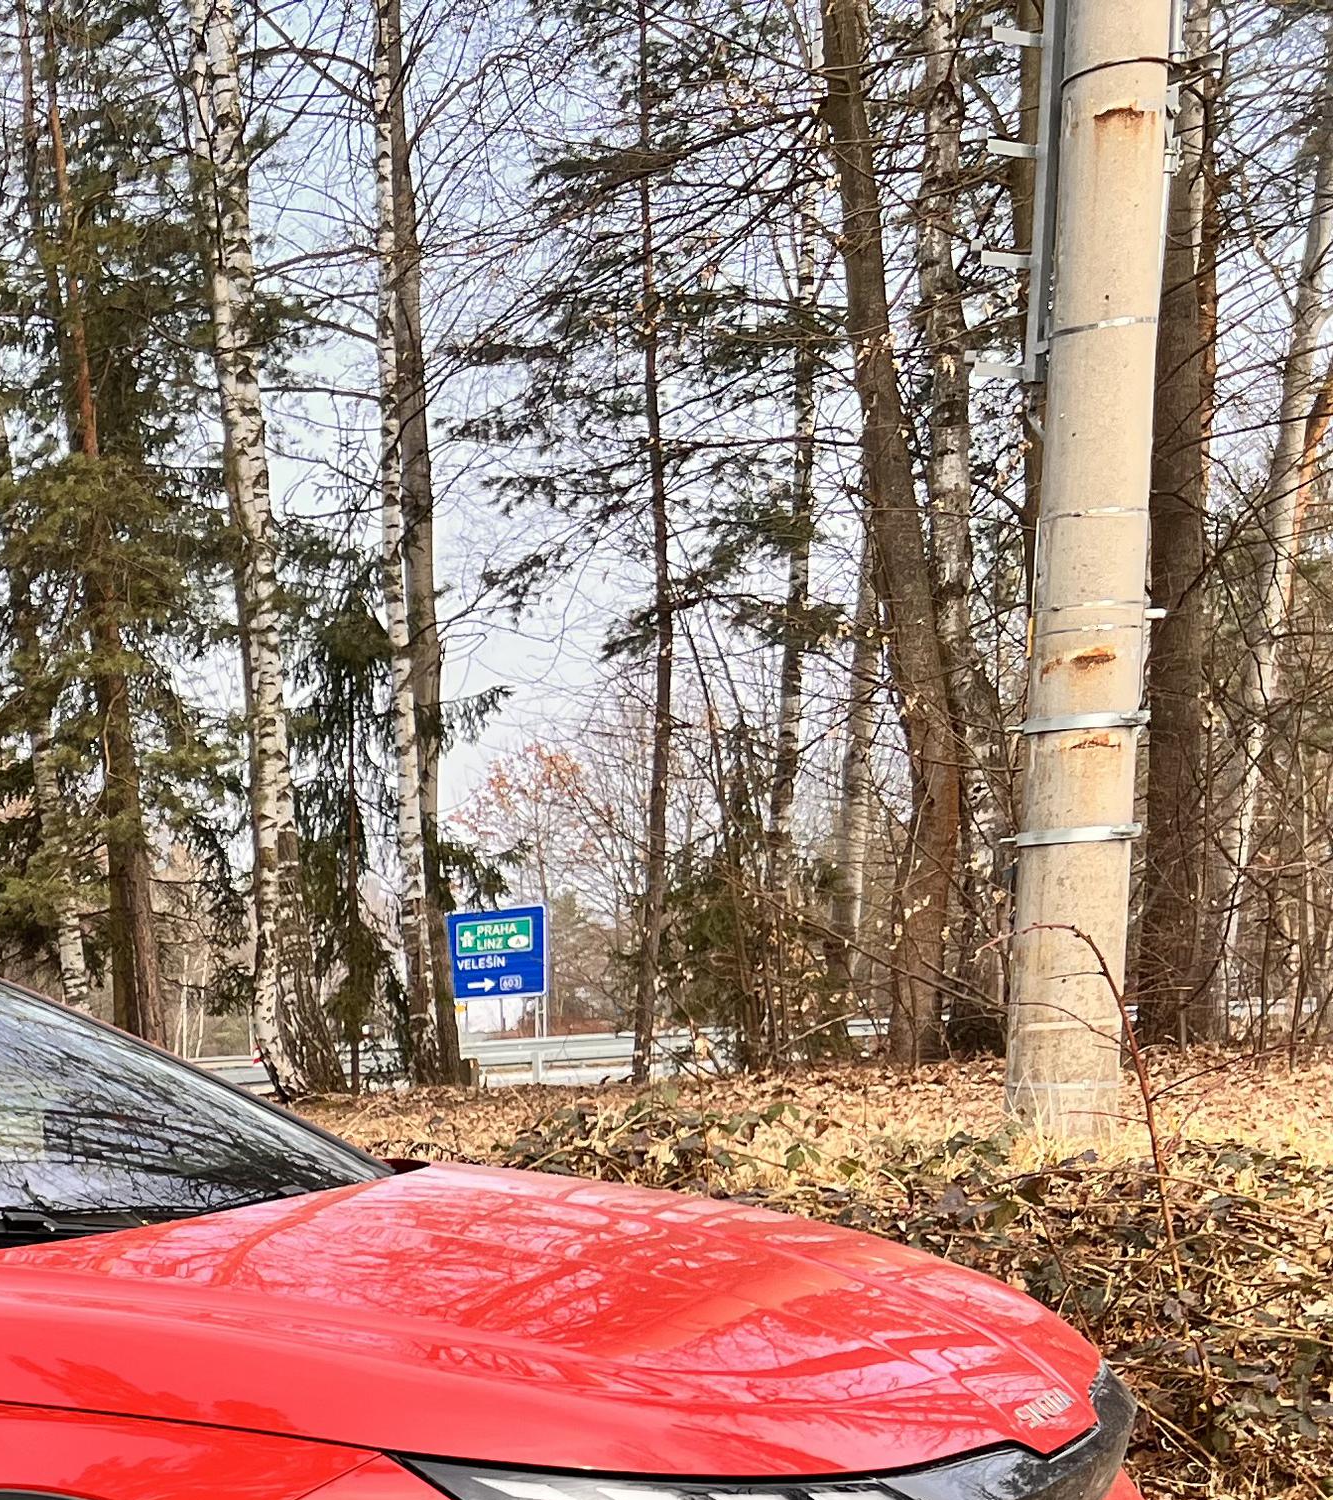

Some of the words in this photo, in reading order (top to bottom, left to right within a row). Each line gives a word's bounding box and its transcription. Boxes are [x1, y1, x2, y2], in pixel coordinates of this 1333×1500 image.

[476, 923, 517, 937] PRAHA
[477, 938, 503, 950] LINZ
[458, 955, 505, 970] VELEŠÍN
